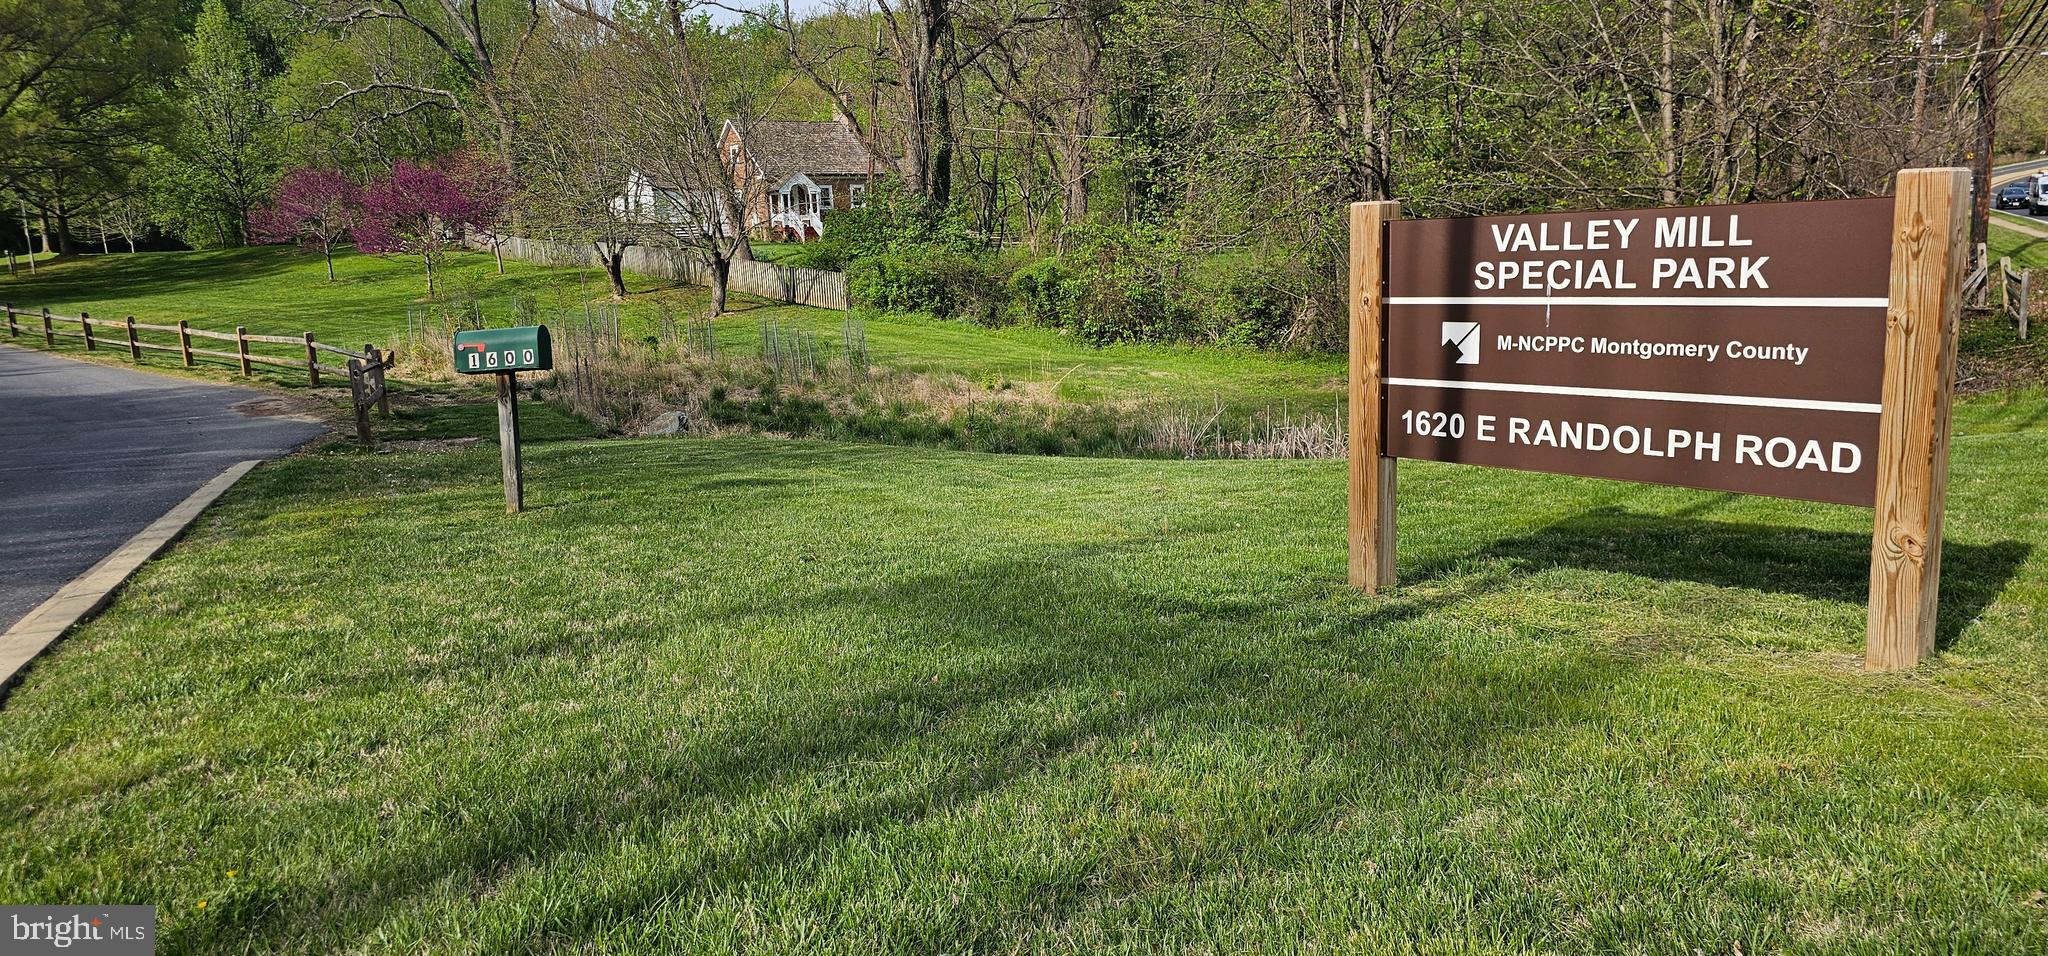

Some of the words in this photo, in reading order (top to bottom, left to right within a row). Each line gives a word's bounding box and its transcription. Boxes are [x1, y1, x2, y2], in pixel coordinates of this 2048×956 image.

[1491, 218, 1639, 252] VALLEY
[1654, 214, 1753, 248] MILL
[1474, 259, 1636, 290] SPECIAL
[1651, 256, 1770, 289] PARK
[471, 350, 533, 367] 1600
[1497, 335, 1585, 353] M-NCPPC
[1590, 337, 1719, 362] Montgomery
[1726, 341, 1809, 365] County
[1401, 410, 1465, 439] 1620
[1477, 415, 1496, 442] E
[1508, 417, 1721, 462] RANDOLPH
[1735, 433, 1862, 474] ROAD
